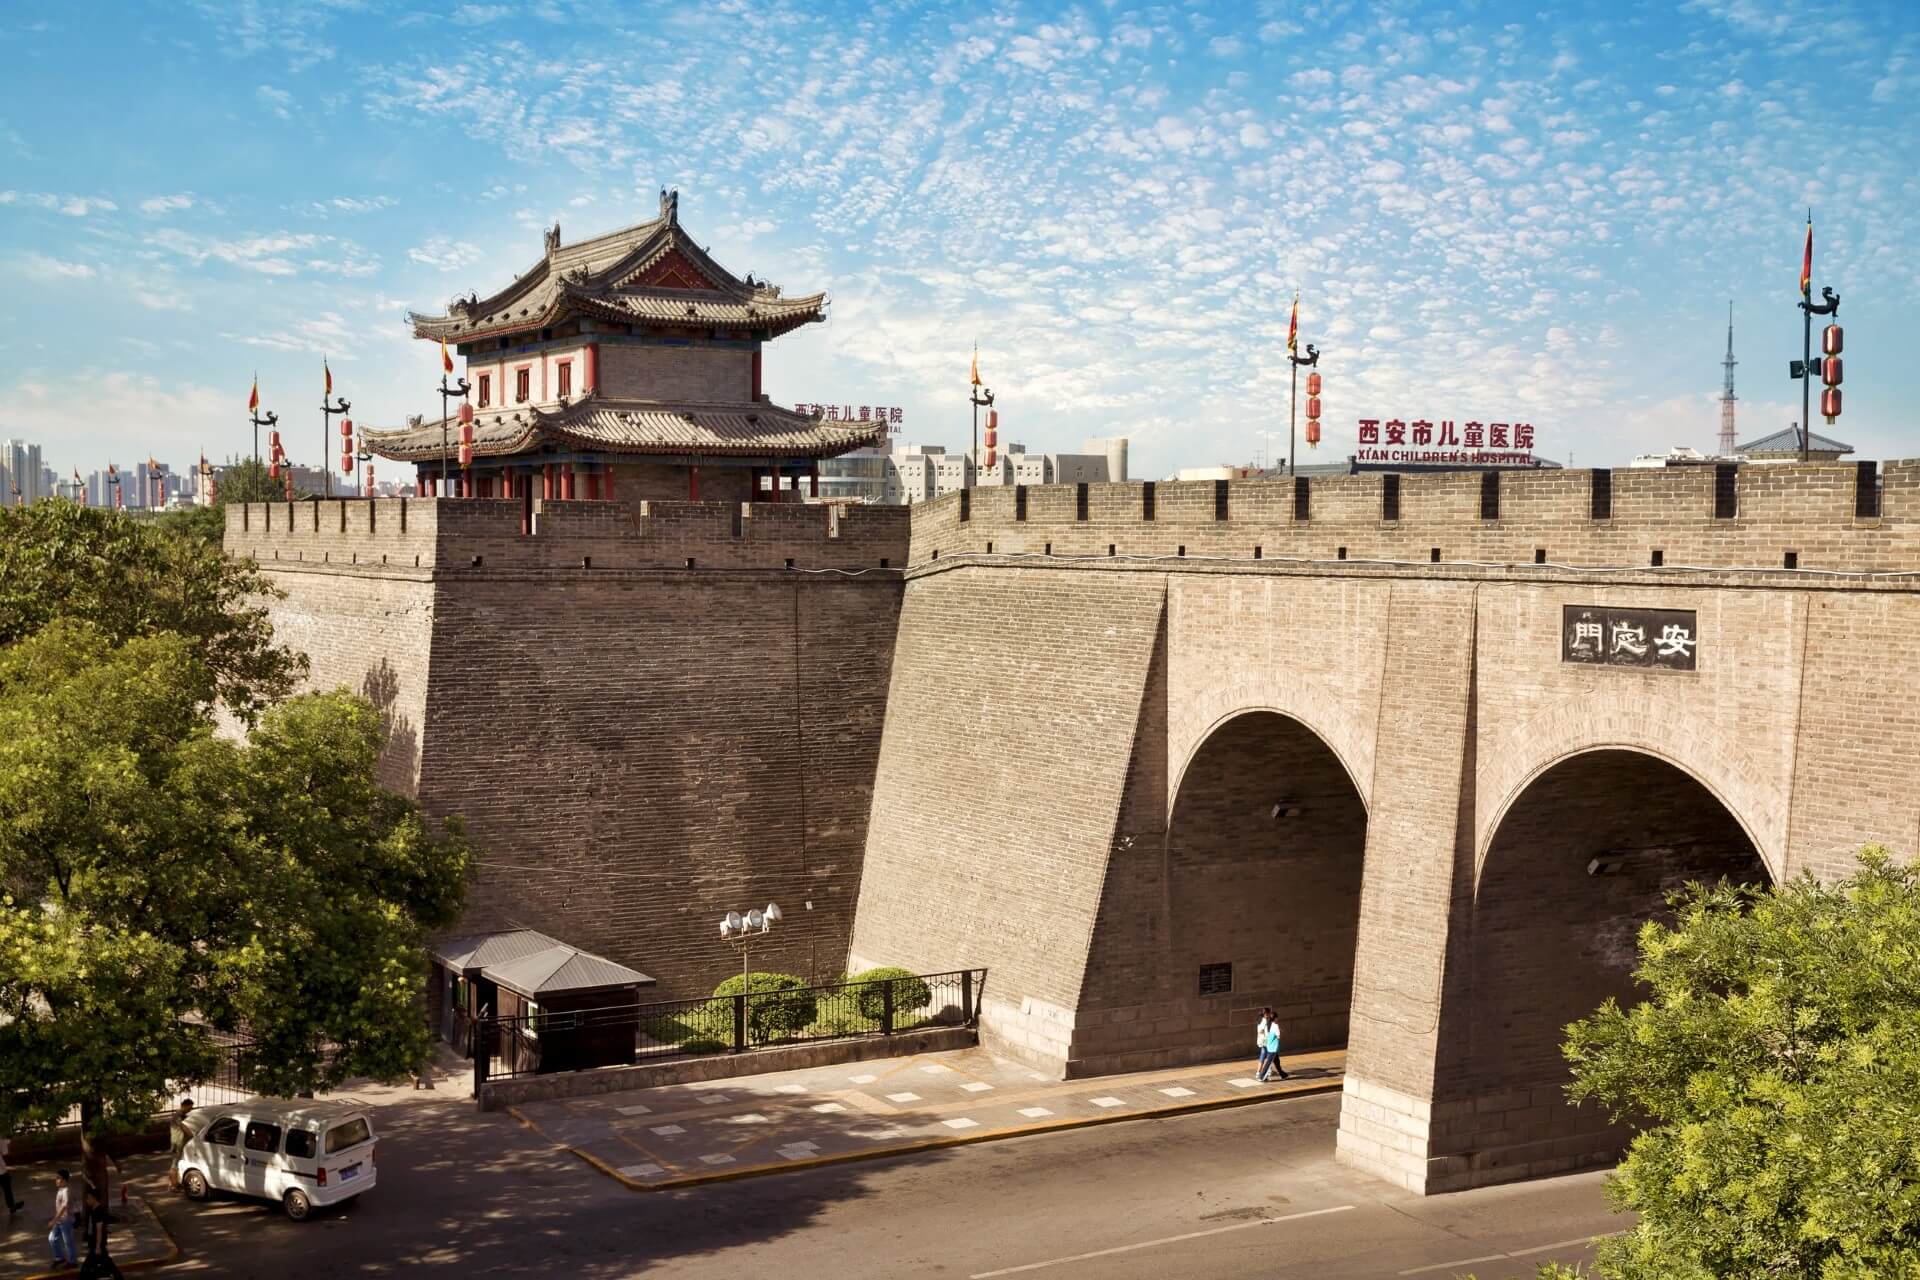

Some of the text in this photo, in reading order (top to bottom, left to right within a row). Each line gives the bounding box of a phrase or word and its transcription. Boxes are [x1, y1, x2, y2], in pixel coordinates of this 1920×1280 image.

[1358, 419, 1535, 449] 西安市儿童医院
[1391, 450, 1468, 463] CHILDREN'S
[1471, 451, 1534, 465] HOSPITAL
